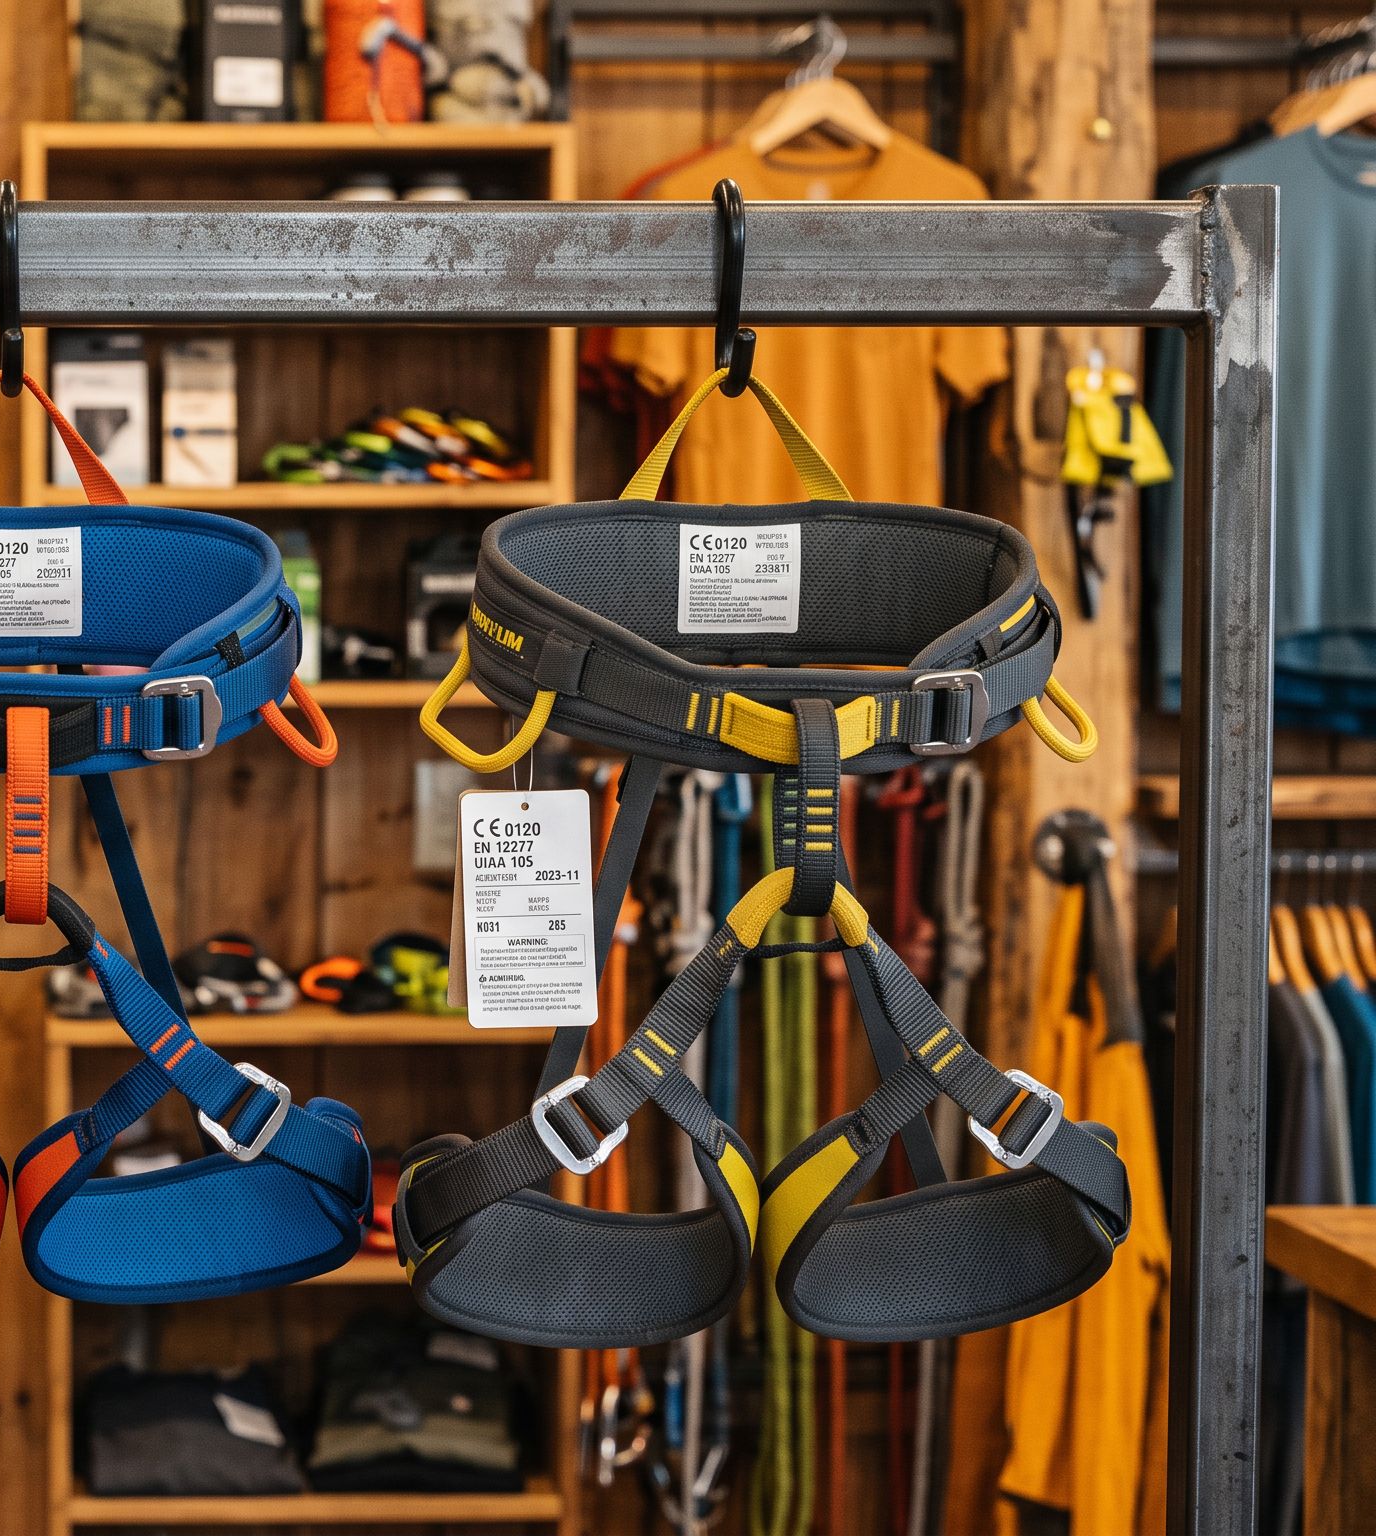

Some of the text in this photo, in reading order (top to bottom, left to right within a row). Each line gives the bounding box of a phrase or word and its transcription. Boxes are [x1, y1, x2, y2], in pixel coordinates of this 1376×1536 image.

[715, 537, 747, 550] 0120
[690, 553, 735, 563] EN 12277
[505, 823, 540, 837] 0120
[475, 841, 533, 853] EN 12277
[475, 857, 506, 868] UIAA
[535, 870, 578, 880] 2023-11
[477, 922, 499, 932] K031
[549, 920, 565, 930] 285
